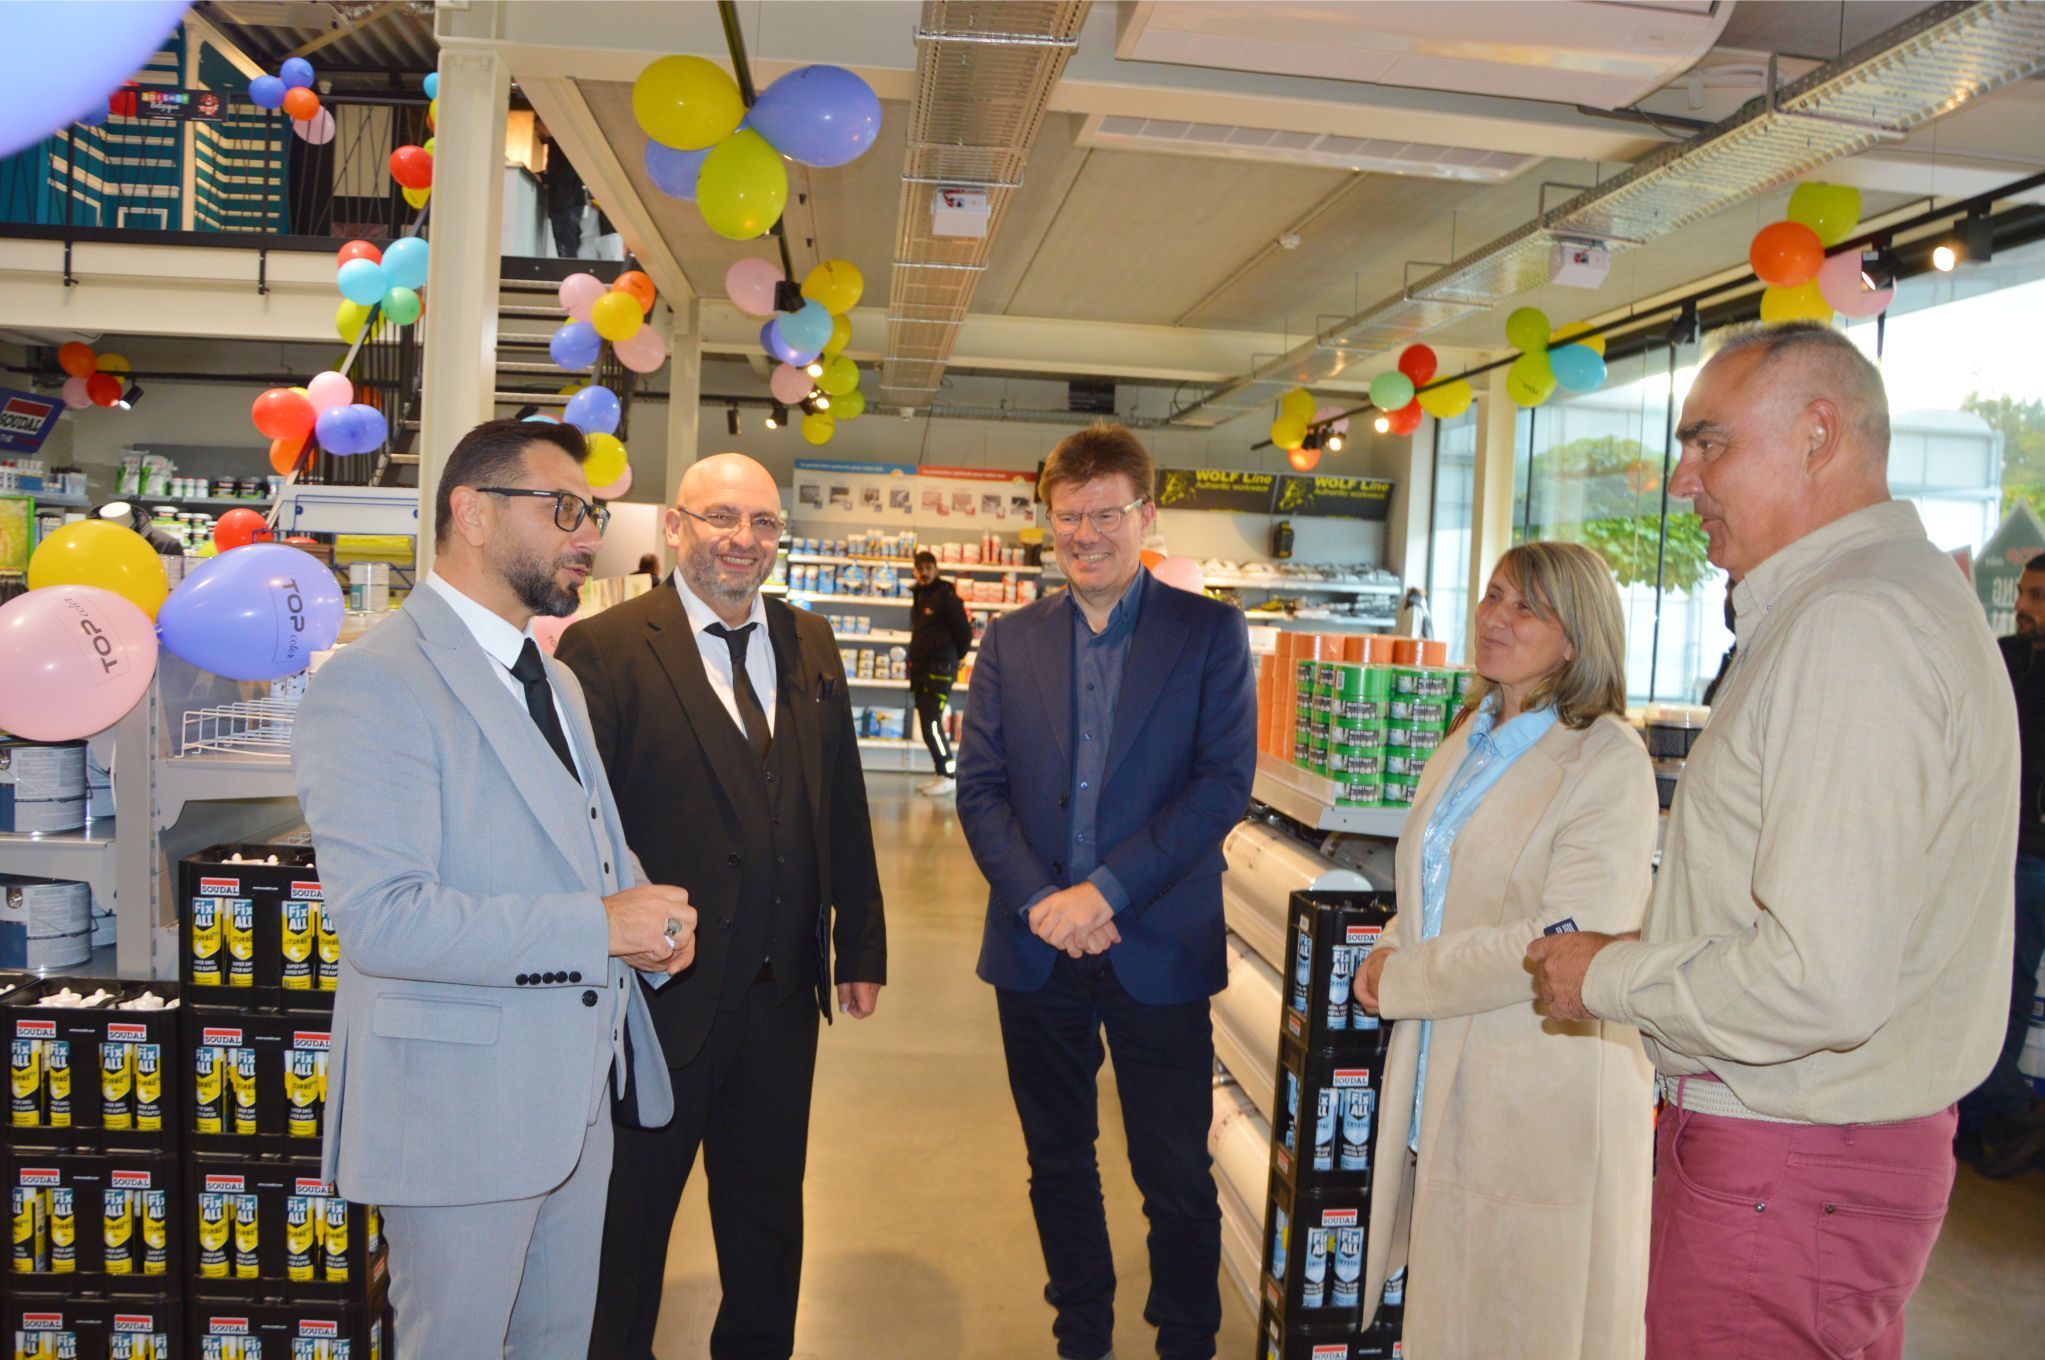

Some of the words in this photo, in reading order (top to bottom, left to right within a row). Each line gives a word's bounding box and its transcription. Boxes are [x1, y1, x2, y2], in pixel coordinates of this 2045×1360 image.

[1196, 470, 1239, 482] WOLF
[1243, 472, 1272, 484] Line
[1315, 476, 1356, 489] WOLF
[1360, 480, 1389, 492] Line
[282, 578, 304, 632] TOP
[81, 620, 118, 674] TOP
[288, 634, 299, 658] color
[293, 889, 322, 897] SOUDA
[195, 902, 213, 914] Fix
[234, 903, 252, 915] Fix
[288, 905, 307, 918] Fix
[195, 914, 213, 926] ALL
[288, 918, 307, 930] ALL
[322, 918, 334, 931] AL
[12, 1042, 30, 1054] Fix
[50, 1043, 67, 1055] Fix
[104, 1045, 123, 1057] Fix
[138, 1048, 155, 1060] Fix
[12, 1054, 30, 1067] ALL
[50, 1055, 68, 1068] ALL
[238, 1051, 255, 1063] Fix
[295, 1052, 313, 1064] Fix
[104, 1058, 123, 1070] ALL
[138, 1060, 156, 1072] ALL
[294, 1064, 312, 1076] ALL
[1352, 1094, 1369, 1104] Fix
[1350, 1105, 1368, 1116] ALL
[54, 1192, 73, 1203] Fix
[105, 1192, 124, 1204] Fix
[203, 1196, 222, 1208] Fix
[54, 1204, 73, 1216] ALL
[105, 1204, 124, 1216] ALL
[237, 1198, 254, 1210] Fix
[288, 1200, 306, 1211] Fix
[327, 1201, 344, 1213] Fix
[203, 1208, 222, 1220] ALL
[237, 1210, 255, 1222] ALL
[288, 1212, 306, 1224] ALL
[327, 1213, 344, 1225] ALL
[1342, 1232, 1358, 1243] Fix
[1341, 1243, 1359, 1255] ALL
[58, 1336, 76, 1346] Fix
[112, 1336, 130, 1346] Fix
[202, 1338, 221, 1350] Fix
[295, 1341, 314, 1353] Fix
[58, 1346, 76, 1359] ALL
[112, 1347, 130, 1359] ALL
[332, 1342, 350, 1354] Fix
